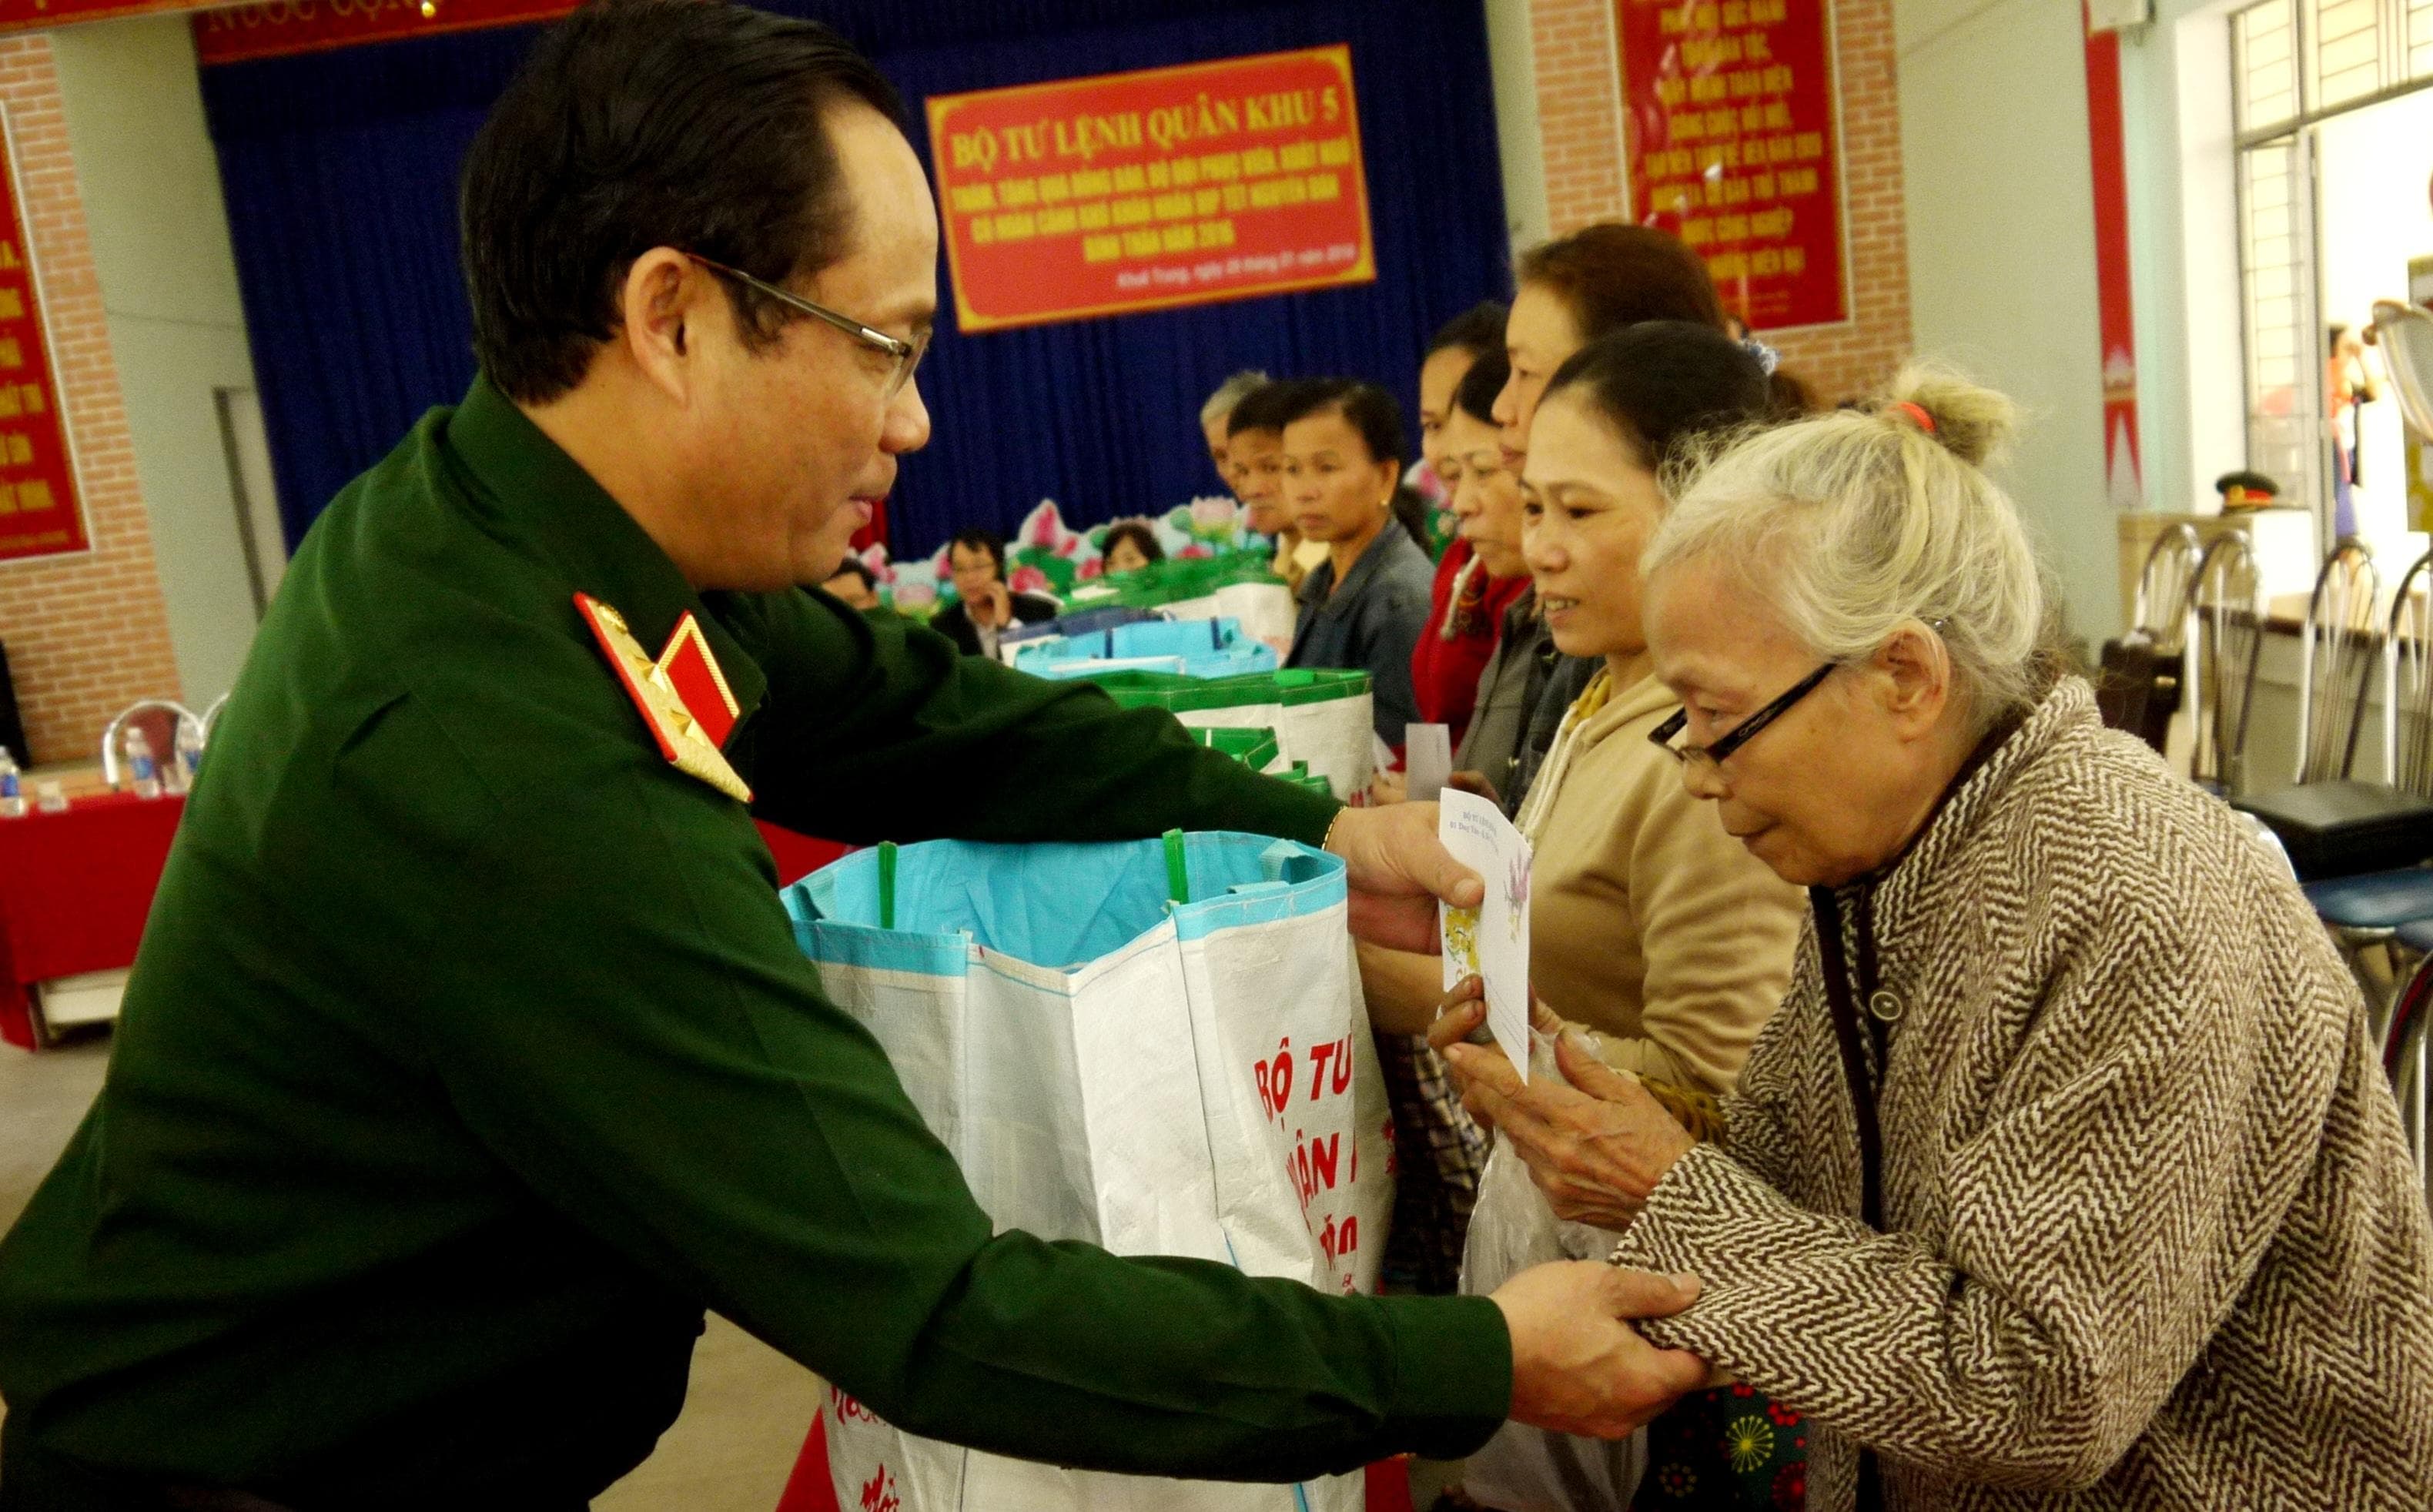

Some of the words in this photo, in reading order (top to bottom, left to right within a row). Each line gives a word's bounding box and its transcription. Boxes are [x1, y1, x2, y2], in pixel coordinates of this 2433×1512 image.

[950, 125, 999, 175] BỘ
[1000, 116, 1051, 162] TƯ
[1054, 111, 1142, 160] LỆNH
[1146, 91, 1240, 151] QUÂN
[1244, 89, 1316, 132] KHU
[1321, 85, 1340, 122] 5
